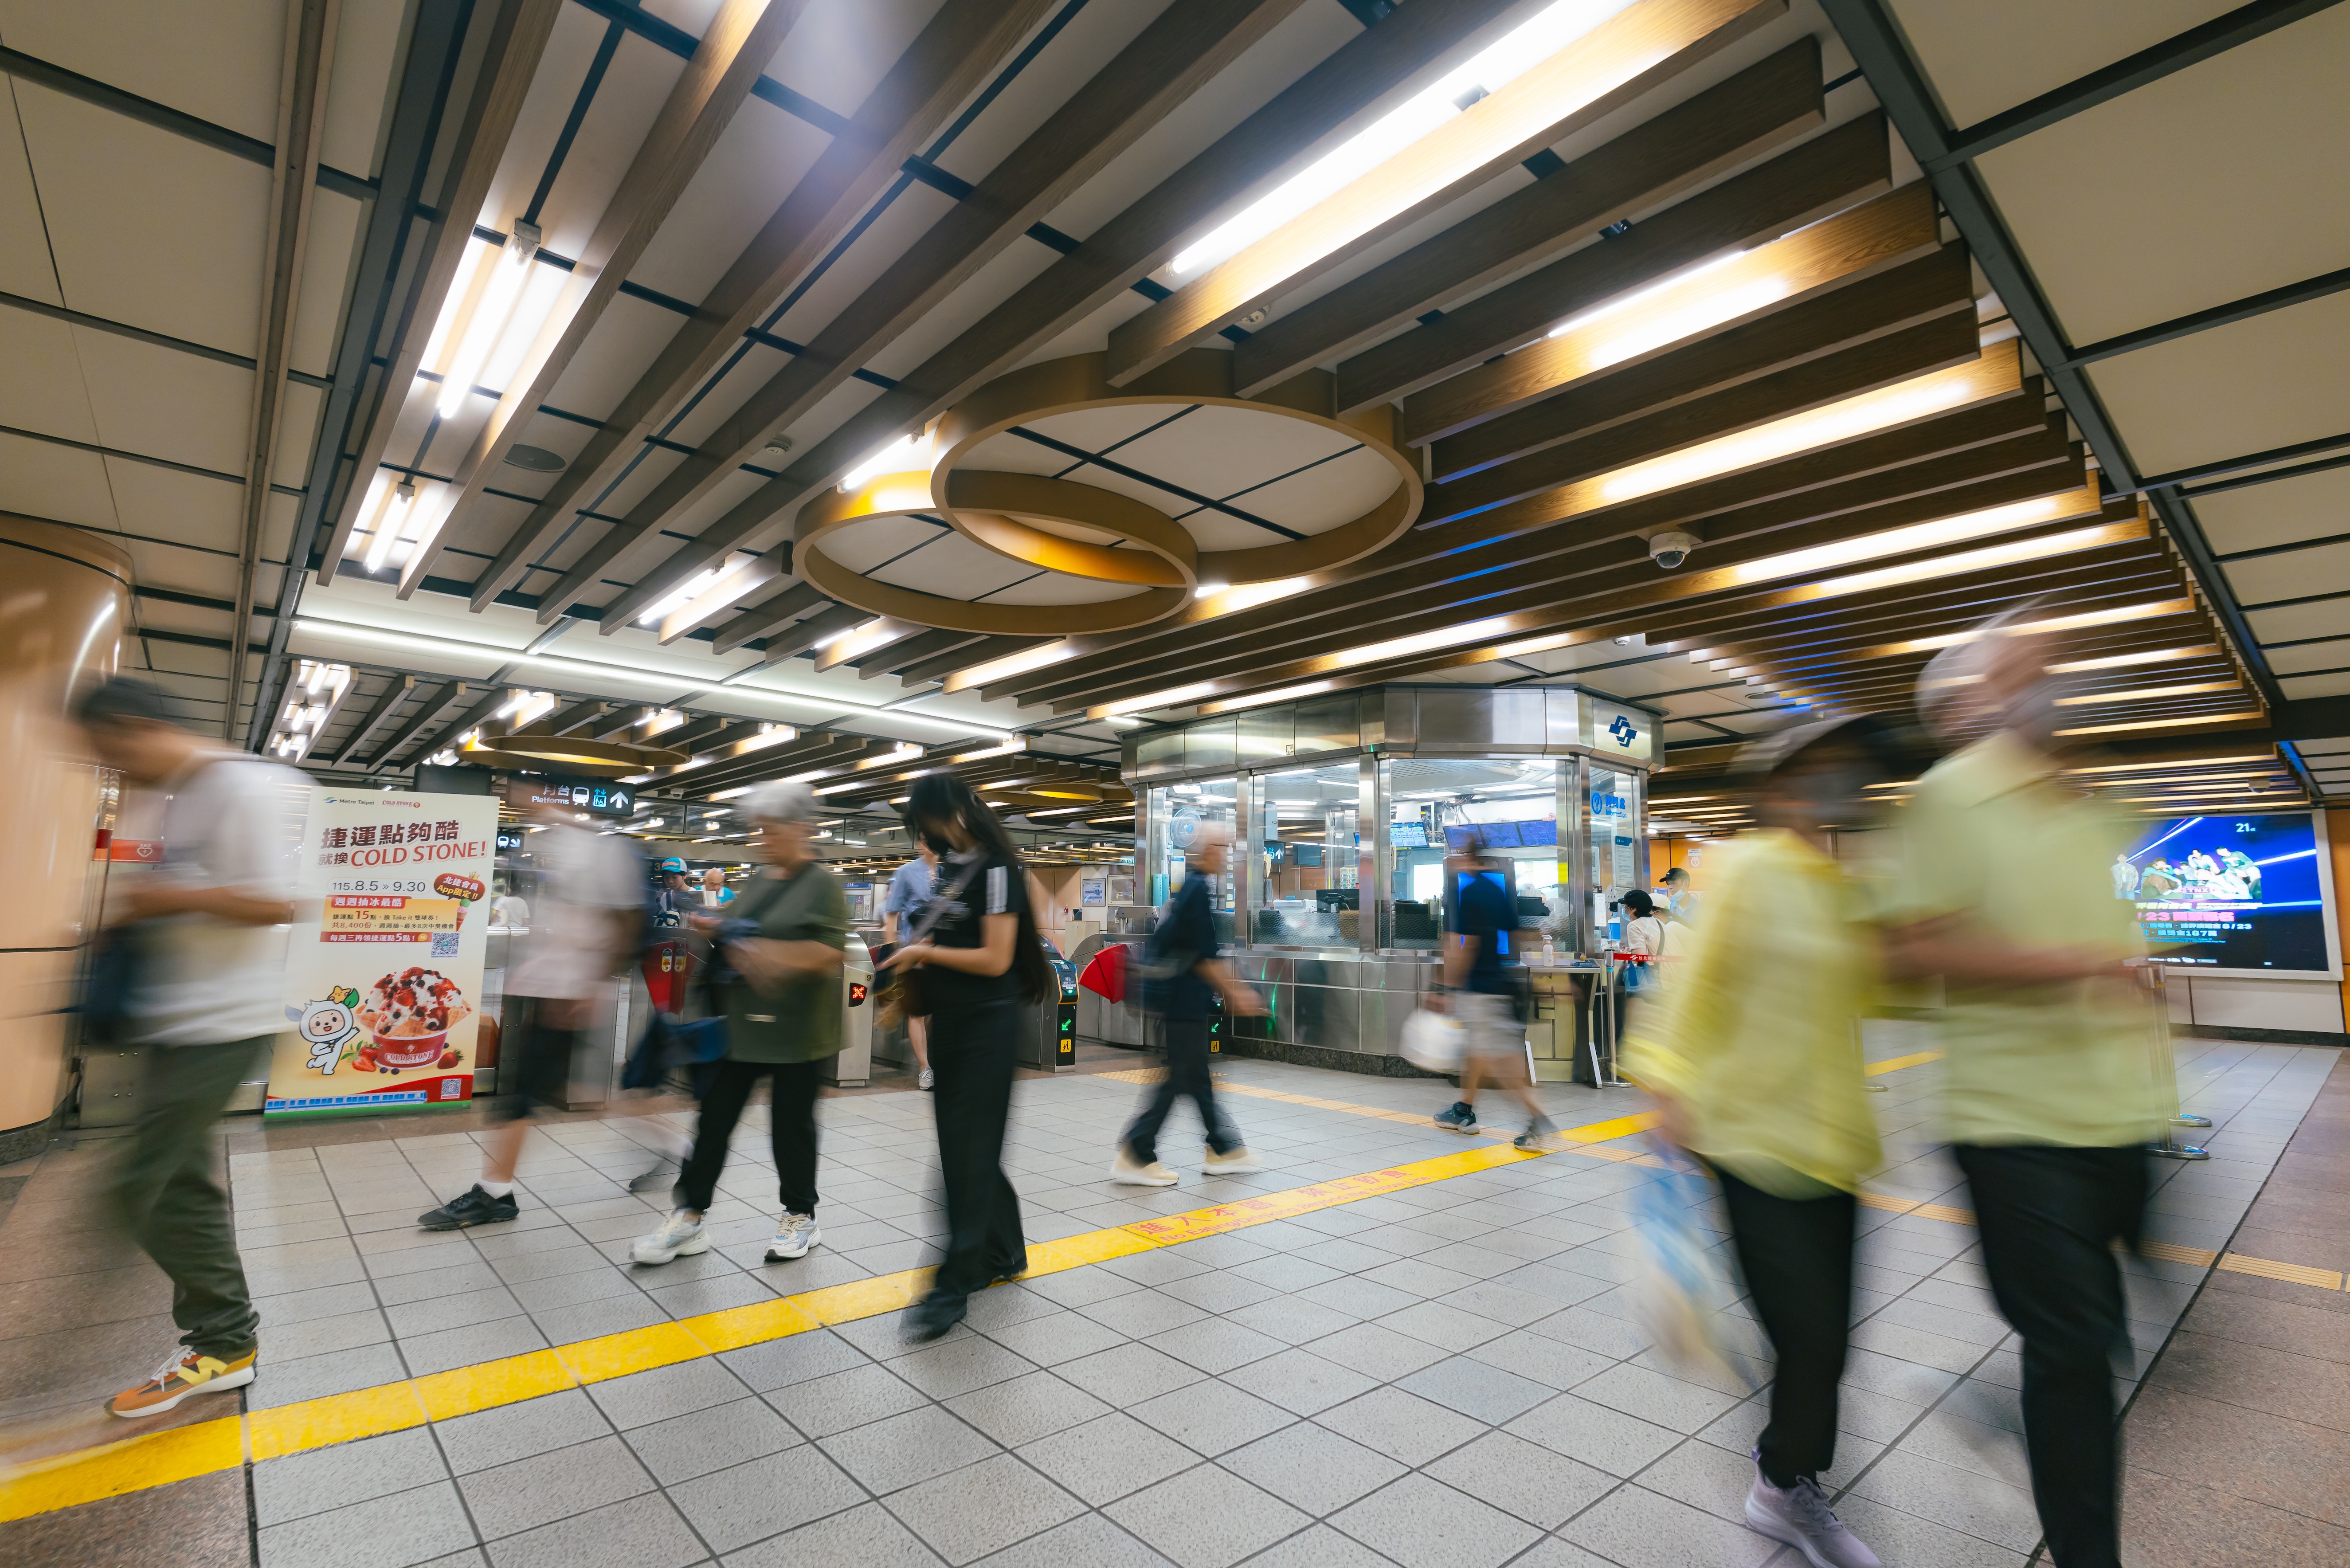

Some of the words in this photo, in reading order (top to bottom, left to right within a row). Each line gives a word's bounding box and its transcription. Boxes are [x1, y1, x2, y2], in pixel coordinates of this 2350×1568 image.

[543, 784, 571, 796] 月台
[531, 795, 569, 805] Platforms
[1606, 809, 1627, 818] Information
[321, 819, 459, 849] 捷運點夠酷
[318, 852, 348, 866] 就換
[351, 847, 407, 867] COLD
[412, 841, 486, 862] STONE!
[654, 862, 660, 871] 3
[332, 880, 379, 891] 115.8.5
[393, 881, 426, 892] 9.30
[443, 876, 480, 891] 北捷會員
[334, 897, 403, 907] 週週抽冰最酷
[384, 1052, 407, 1062] COLD
[407, 1050, 435, 1061] STONE
[1130, 1199, 1277, 1235] 進入本區
[1296, 1170, 1413, 1197] 禁止飲食
[1158, 1233, 1186, 1242] No
[1184, 1207, 1301, 1236] Eating/Drinking
[1296, 1194, 1349, 1210] Beyond
[1345, 1190, 1370, 1200] the
[1367, 1180, 1407, 1193] Yellow
[1402, 1176, 1431, 1185] Line
